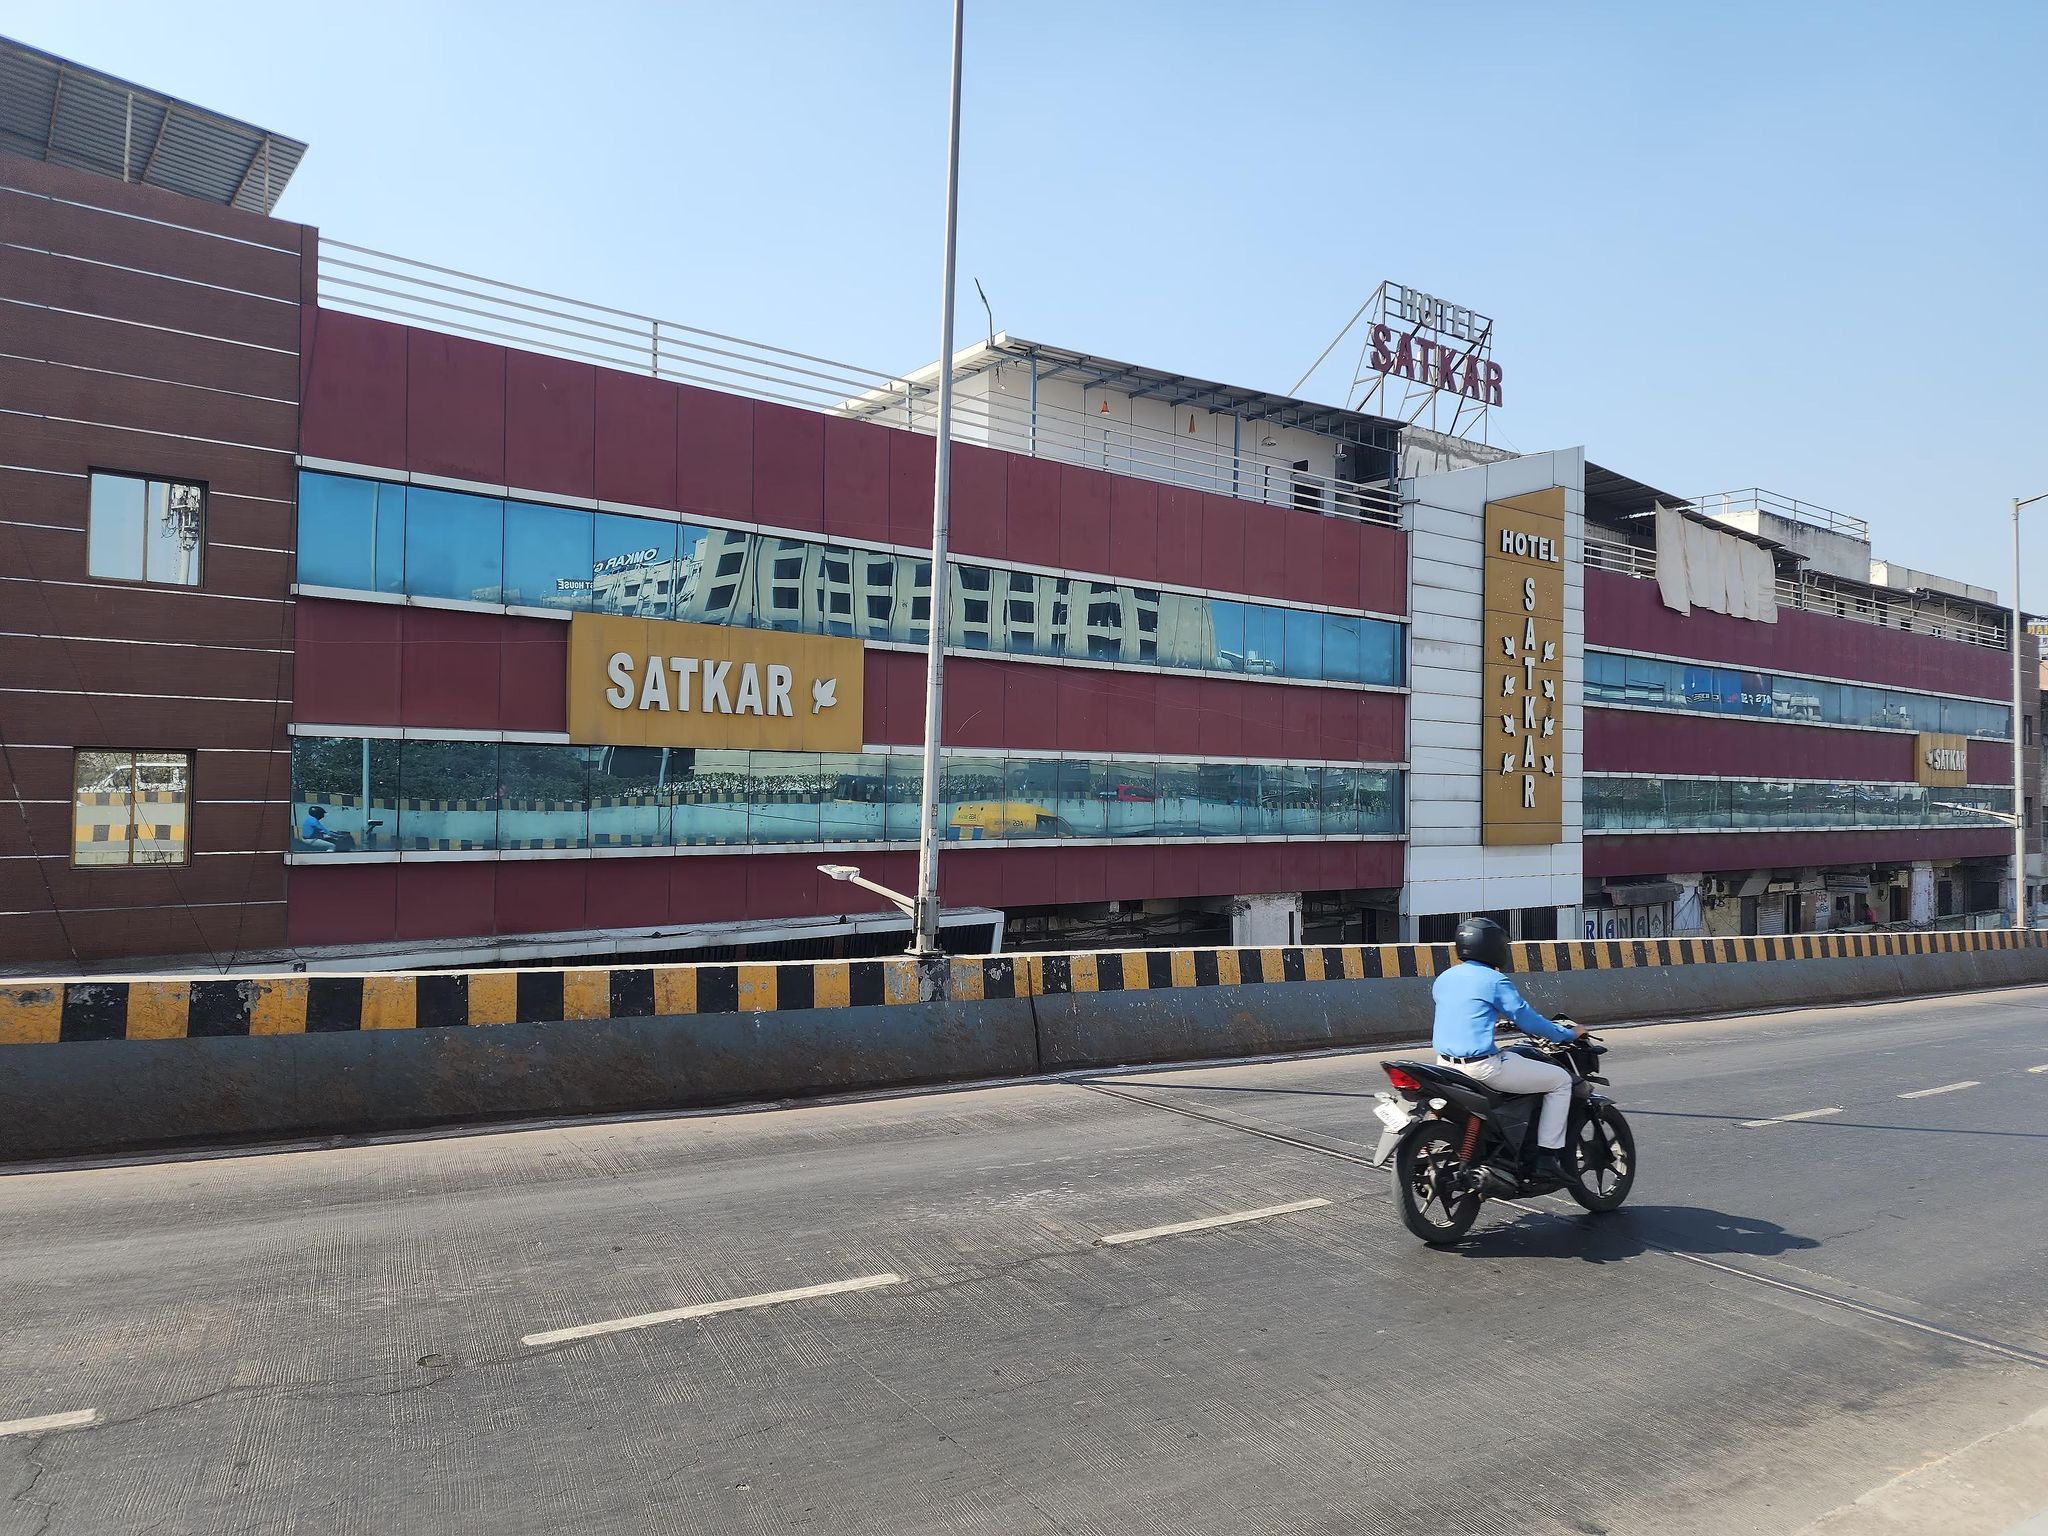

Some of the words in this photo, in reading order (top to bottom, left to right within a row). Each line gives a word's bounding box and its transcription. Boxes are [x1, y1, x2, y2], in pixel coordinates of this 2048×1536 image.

[1400, 285, 1482, 344] HOTEL
[1370, 323, 1503, 407] SATKAR
[1502, 529, 1560, 563] HOTEL
[605, 651, 794, 717] SATKAR
[1524, 577, 1537, 809] SATKAR
[1934, 748, 1967, 772] SATKAR
[1585, 915, 1647, 939] RANA
